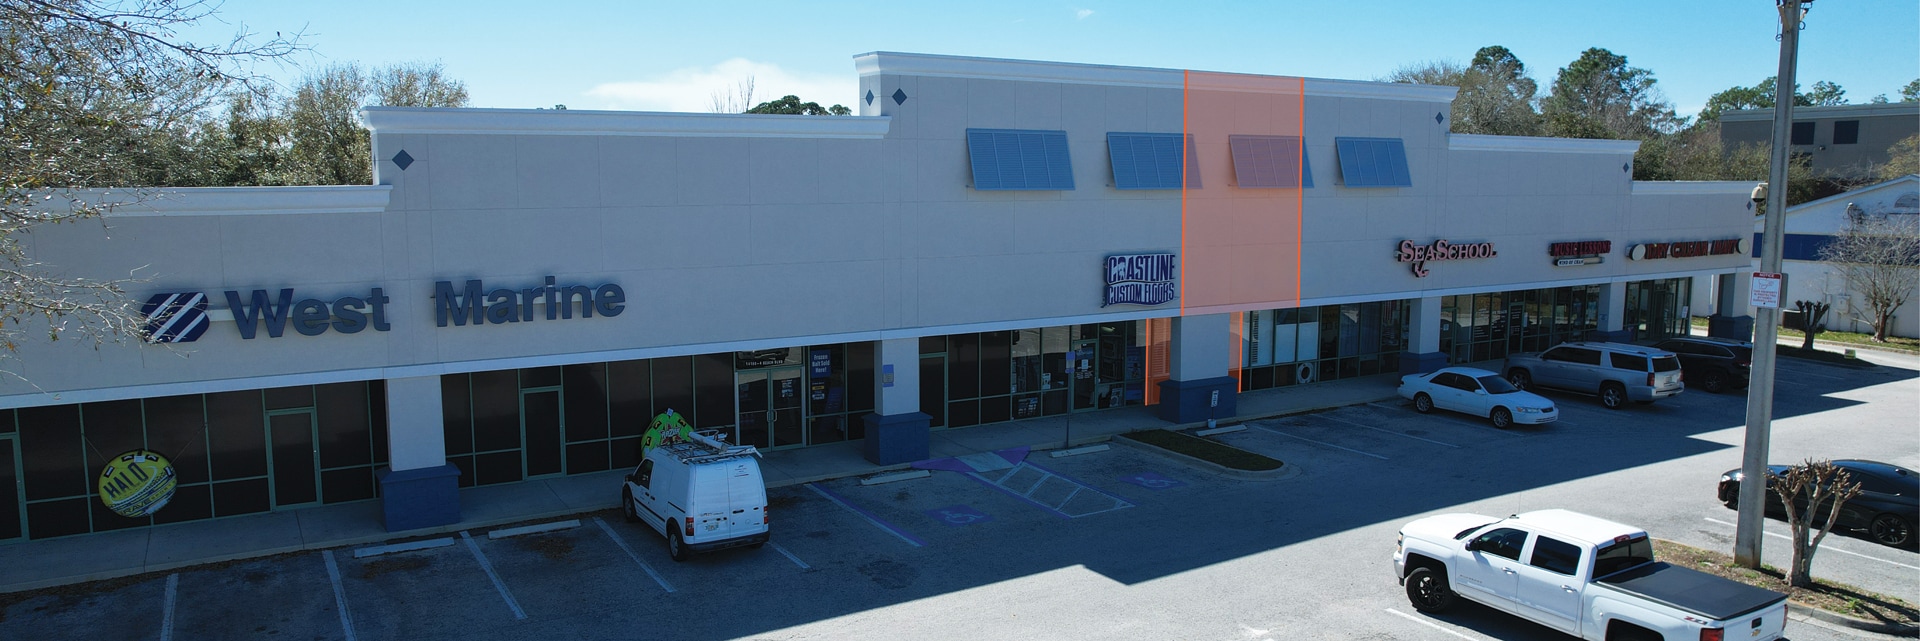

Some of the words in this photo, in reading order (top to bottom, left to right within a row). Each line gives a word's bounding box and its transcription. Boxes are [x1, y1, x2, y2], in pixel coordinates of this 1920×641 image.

[1552, 242, 1578, 257] MUSIC
[1645, 242, 1670, 260] DRY
[1671, 241, 1709, 258] CLEAN
[1108, 254, 1176, 284] COASTLINE
[1108, 284, 1142, 305] CUSTOM
[1144, 283, 1175, 304] FLOORS
[224, 288, 391, 340] West
[435, 275, 626, 328] Marine
[103, 462, 149, 498] HALO
